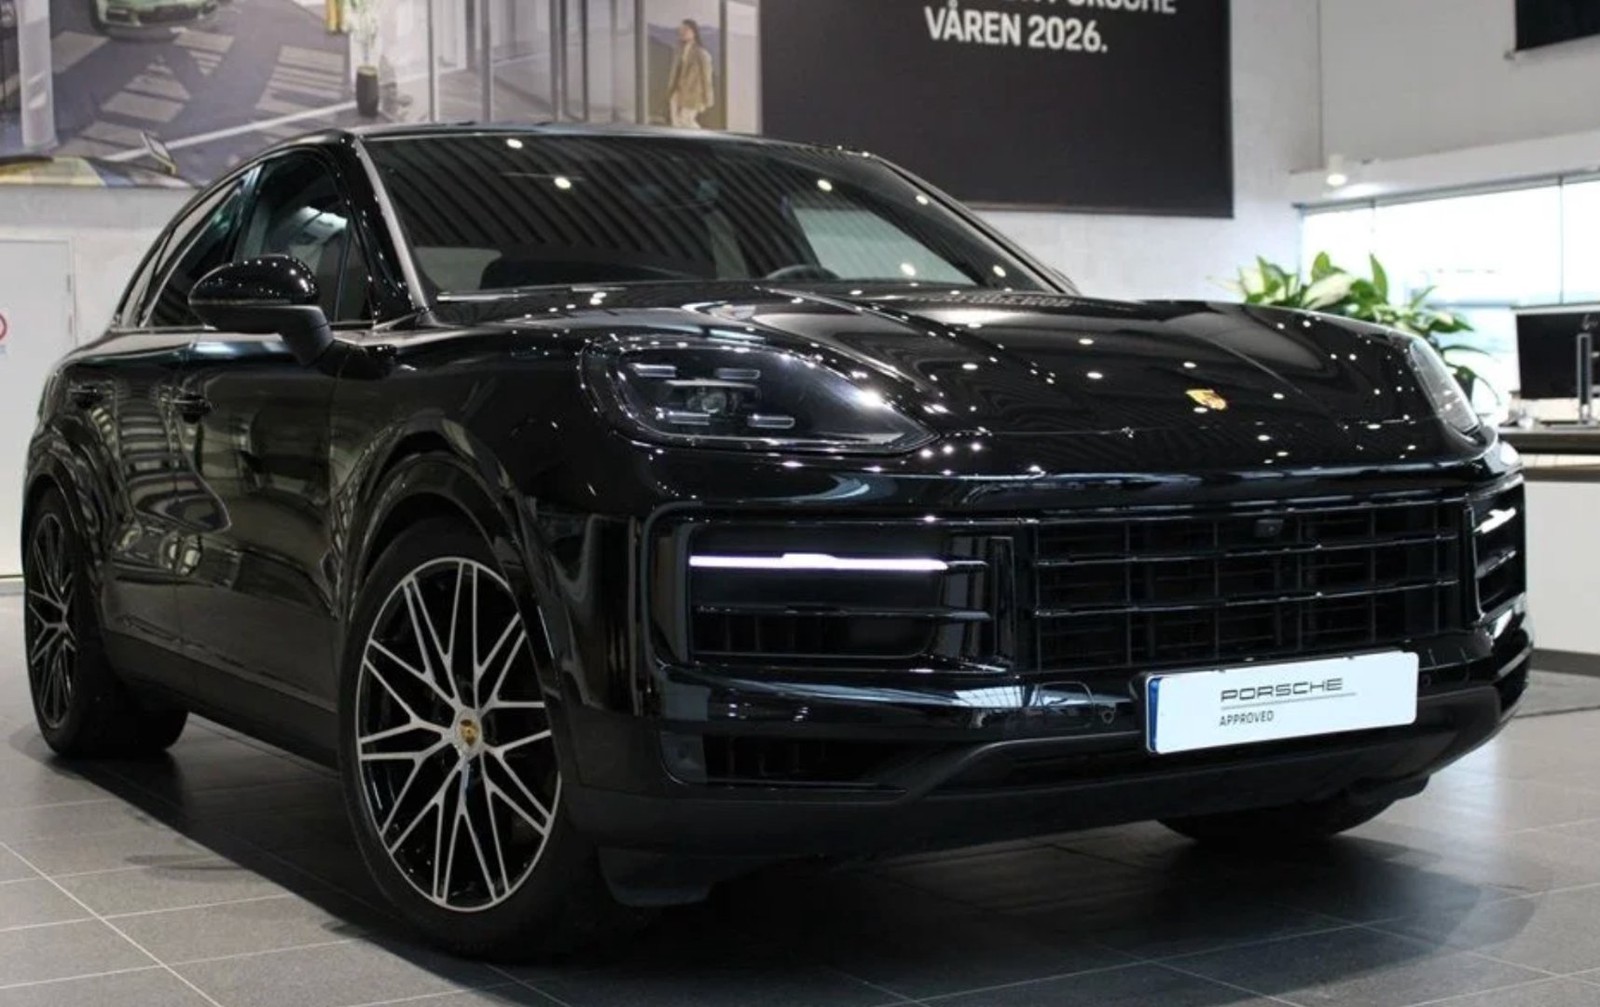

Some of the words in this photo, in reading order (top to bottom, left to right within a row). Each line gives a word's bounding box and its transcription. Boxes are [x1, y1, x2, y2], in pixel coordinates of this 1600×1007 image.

[924, 0, 1021, 46] VÅREN
[1027, 15, 1108, 52] 2026.
[1220, 677, 1343, 702] PORSCHE
[1219, 709, 1274, 726] APPROVED
